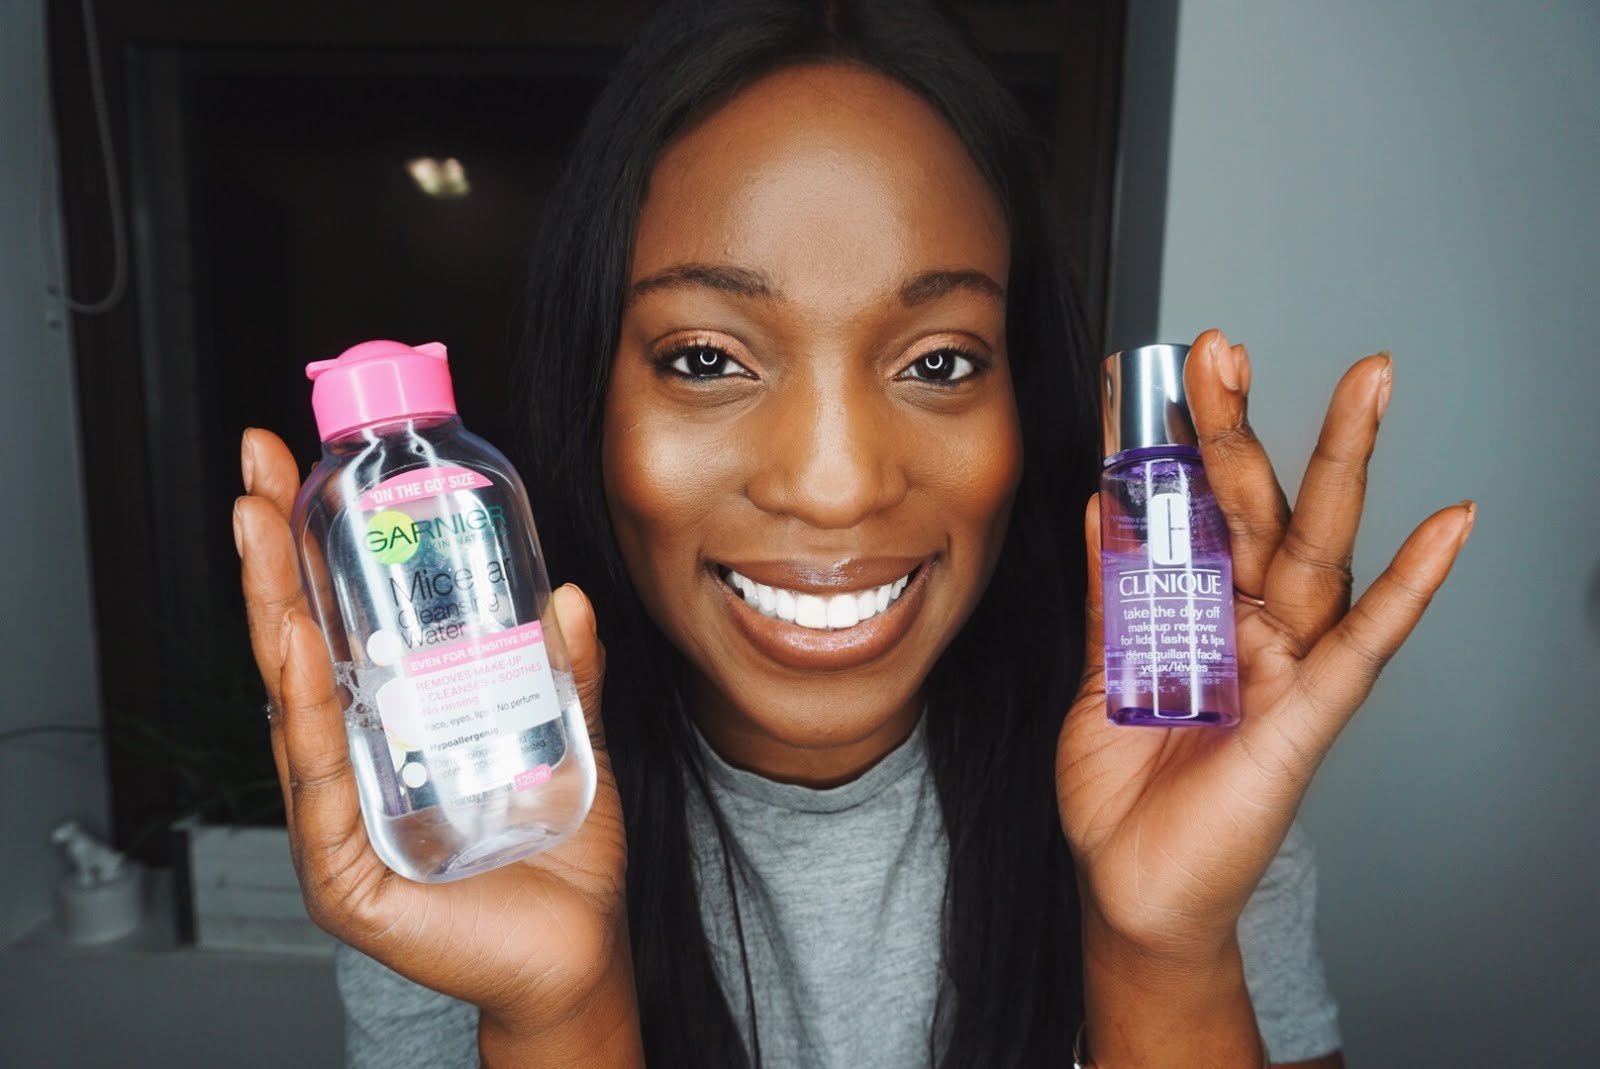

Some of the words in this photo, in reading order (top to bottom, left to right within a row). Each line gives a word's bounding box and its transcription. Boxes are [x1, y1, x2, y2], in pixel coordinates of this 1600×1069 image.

[396, 482, 422, 500] THE
[449, 472, 476, 489] SIZE
[390, 556, 511, 606] Micear
[1119, 573, 1222, 596] CLINIQUE
[398, 592, 500, 629] Cleansig
[1123, 606, 1149, 620] take
[1154, 605, 1175, 618] the
[1206, 606, 1221, 618] off
[401, 621, 466, 649] Water
[1120, 635, 1133, 646] for
[1201, 634, 1209, 644] &
[1210, 635, 1225, 647] lips
[1128, 622, 1170, 634] makup
[1174, 622, 1218, 632] reover
[410, 655, 441, 672] EVEN
[444, 650, 467, 664] FOR
[519, 629, 540, 642] SKIN
[1126, 648, 1194, 662] démaquillan
[1197, 648, 1222, 660] facile
[415, 670, 473, 692] REMOVES
[474, 655, 522, 676] MAKE-UP
[1141, 661, 1208, 675] yeux/lèves
[427, 678, 489, 702] CLEANSES
[498, 662, 543, 682] SOOTHES
[497, 703, 509, 713] No
[510, 693, 541, 709] perfume
[430, 727, 500, 752] Hypoallergenic
